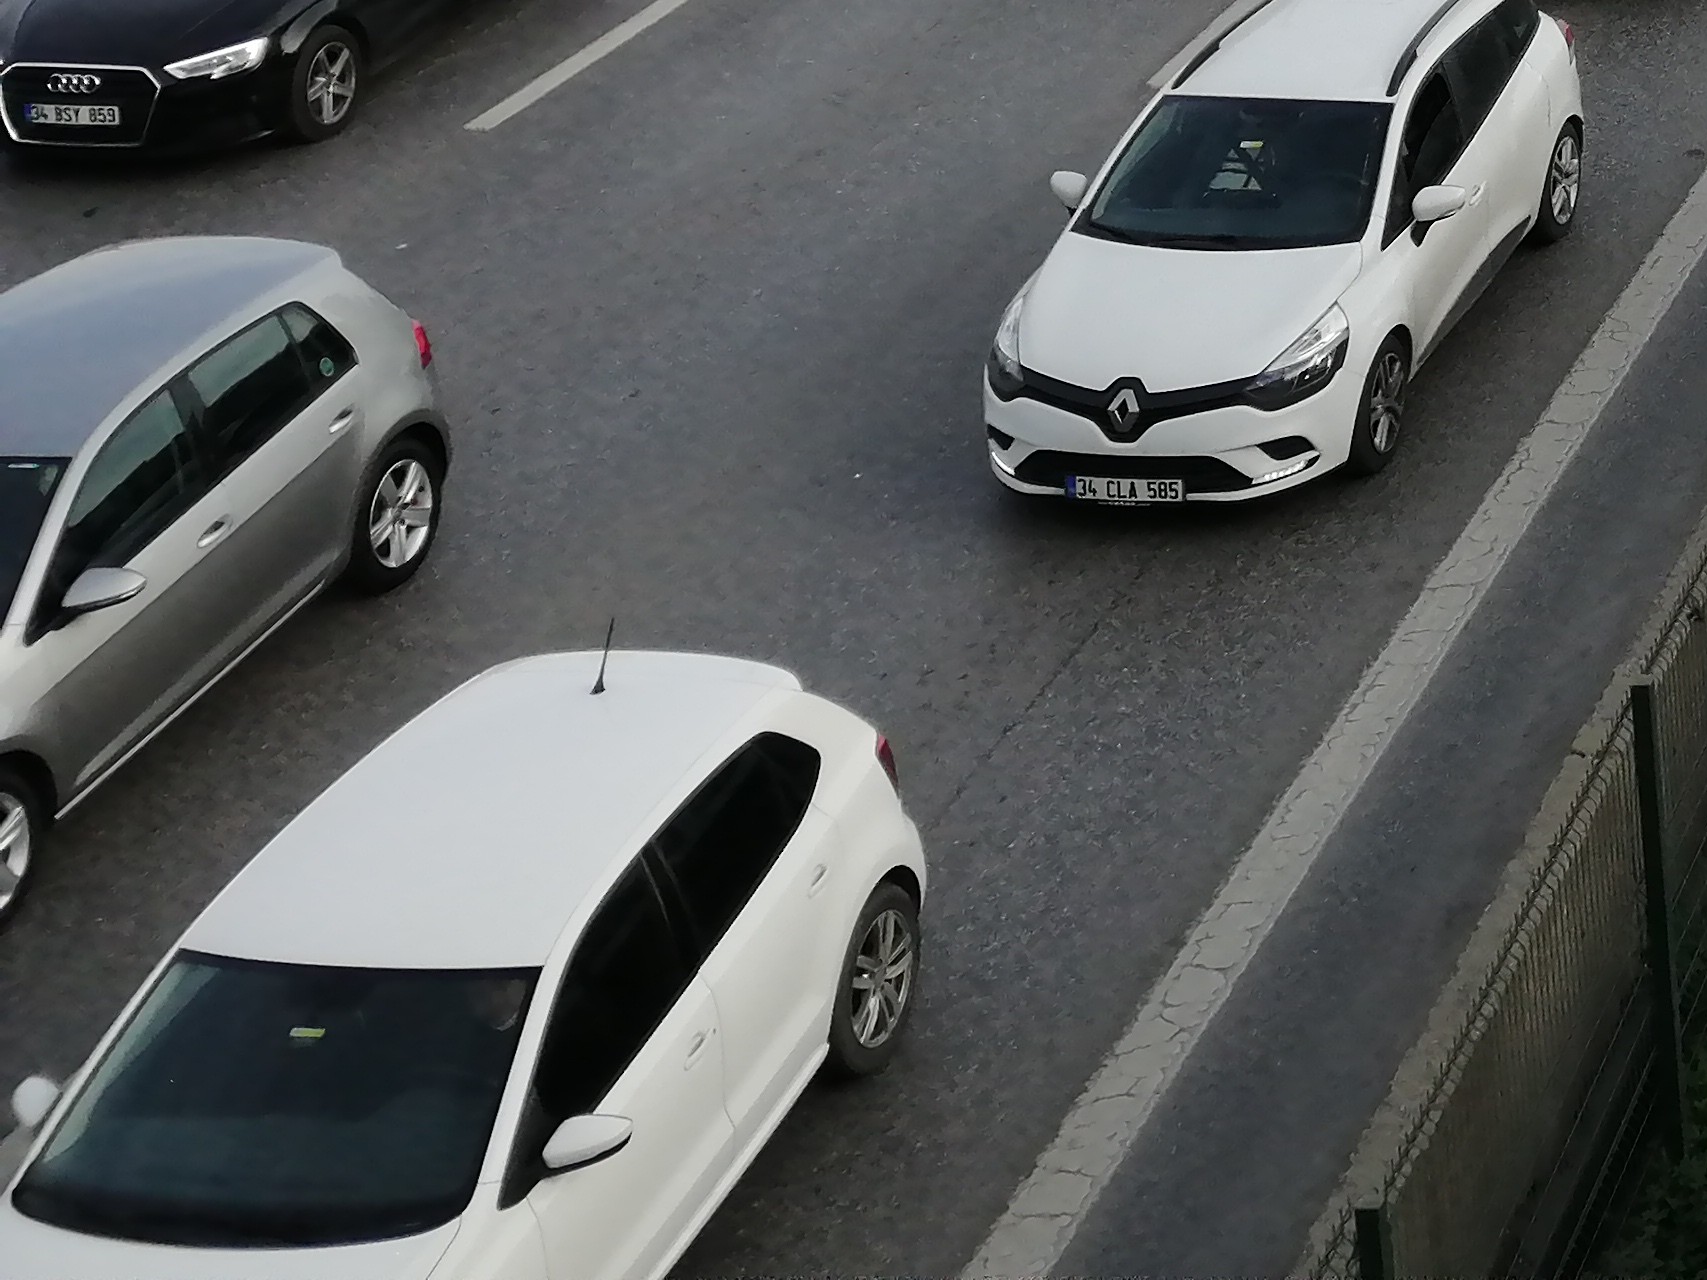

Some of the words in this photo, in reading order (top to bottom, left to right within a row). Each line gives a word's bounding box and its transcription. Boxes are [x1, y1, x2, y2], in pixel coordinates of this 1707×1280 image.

[32, 105, 48, 121] 34
[54, 106, 81, 123] BSY
[1077, 478, 1097, 497] 34
[1106, 479, 1138, 500] CLA
[1147, 480, 1179, 500] 585
